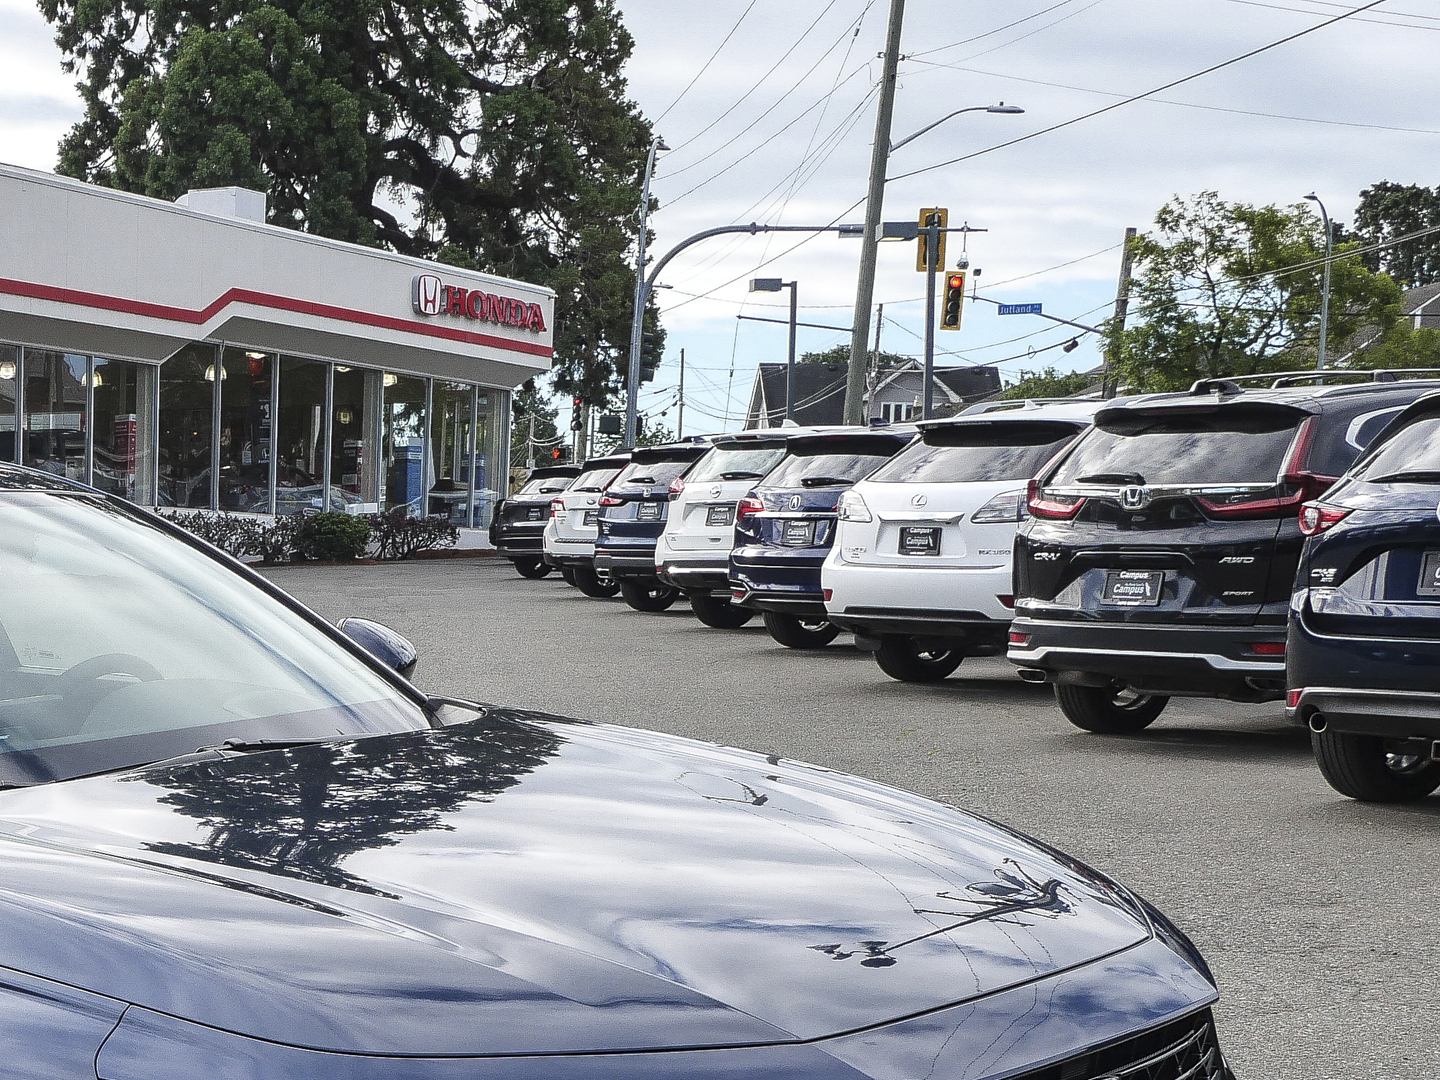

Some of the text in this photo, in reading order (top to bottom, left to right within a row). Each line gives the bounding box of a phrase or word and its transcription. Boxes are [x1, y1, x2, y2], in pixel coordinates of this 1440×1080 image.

[445, 285, 547, 332] HONDA
[1000, 305, 1032, 314] Jutland
[1034, 552, 1061, 560] CR-V
[1218, 556, 1255, 564] AWD
[1120, 571, 1149, 580] Campus
[1113, 583, 1145, 595] Campus
